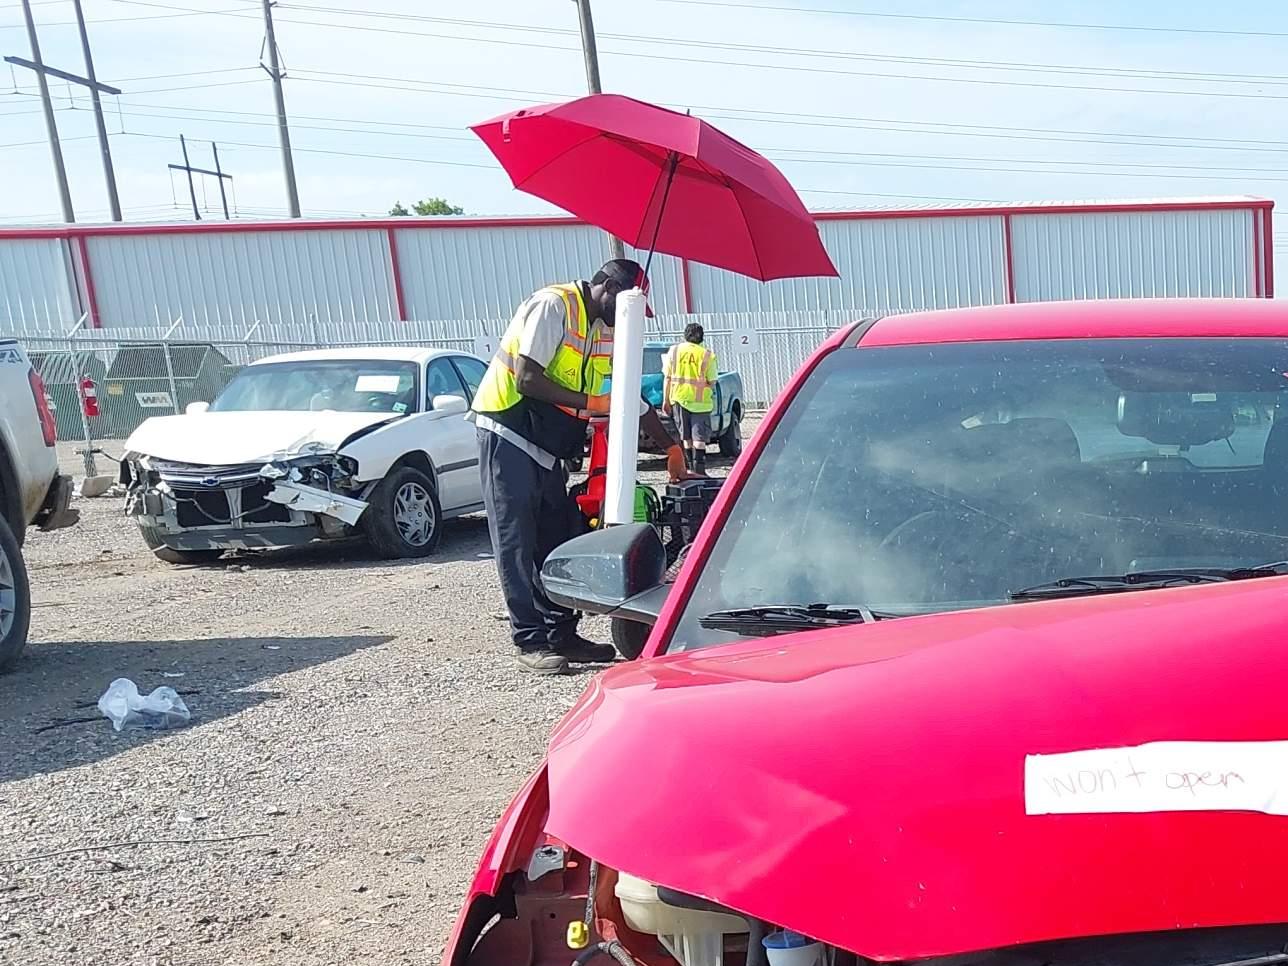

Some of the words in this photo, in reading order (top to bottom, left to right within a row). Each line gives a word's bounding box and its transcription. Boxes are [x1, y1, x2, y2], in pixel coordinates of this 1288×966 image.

[741, 335, 749, 345] 2
[485, 343, 491, 353] 1
[1165, 771, 1246, 797] open
